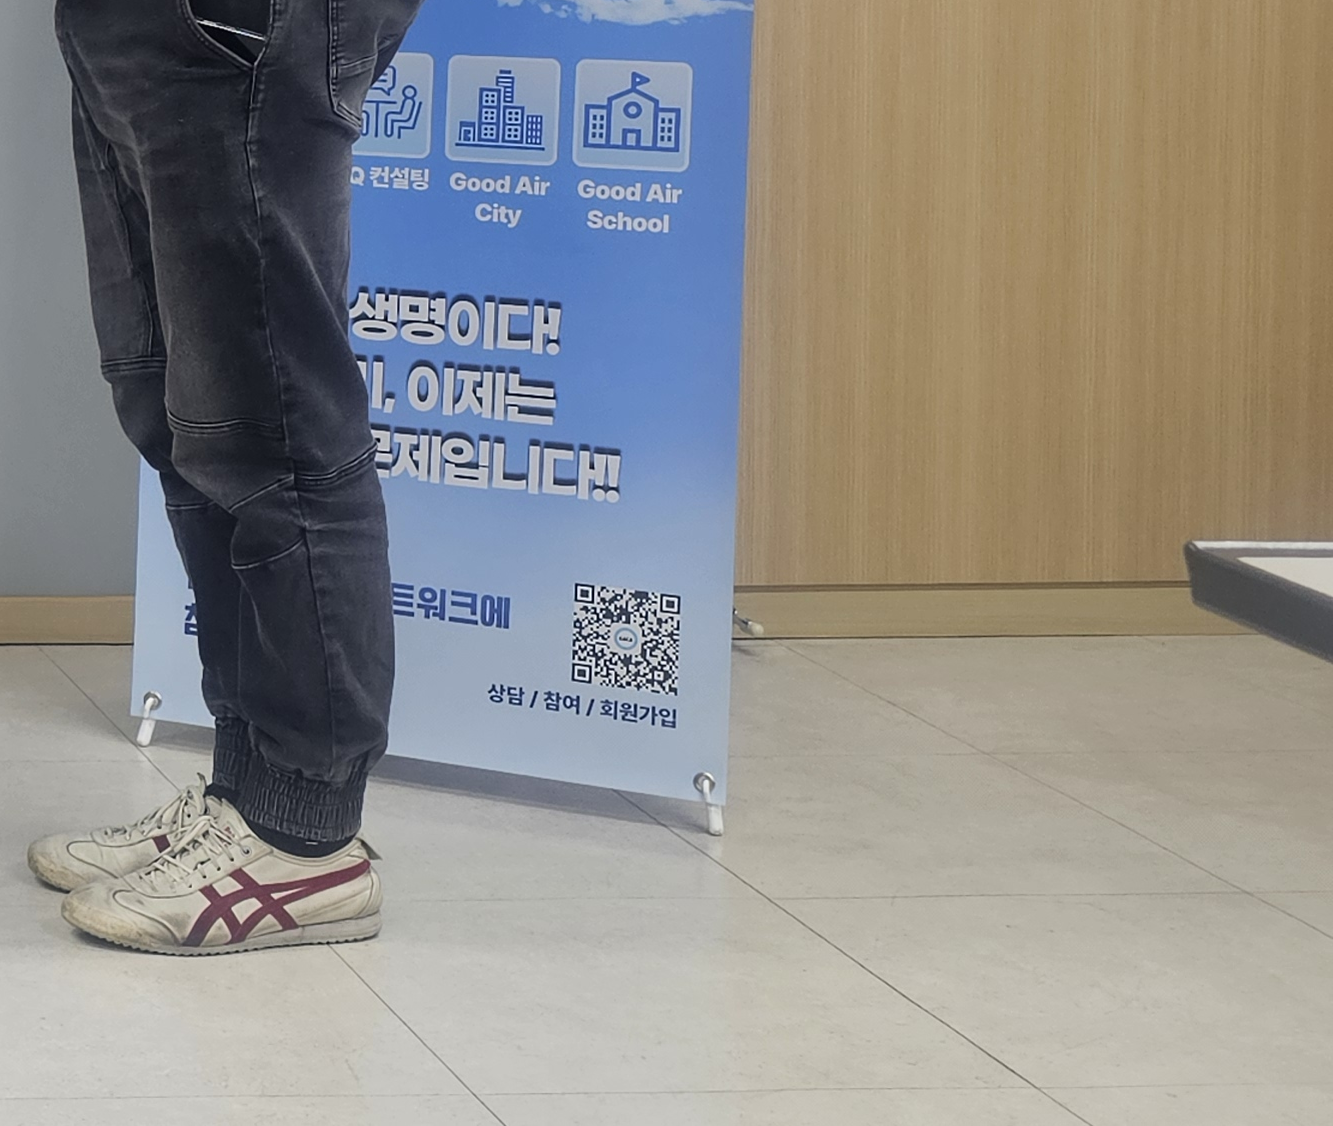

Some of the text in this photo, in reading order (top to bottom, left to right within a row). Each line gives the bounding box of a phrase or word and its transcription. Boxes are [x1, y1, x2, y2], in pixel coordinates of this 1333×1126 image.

[369, 165, 430, 191] 컨설팅
[449, 172, 551, 197] Good Air
[577, 179, 683, 204] Good Air
[474, 202, 523, 229] City
[586, 209, 670, 234] School
[349, 291, 562, 356] 생명이다!
[406, 365, 557, 426] 이제는
[487, 683, 526, 707] 상담
[543, 690, 582, 716] 참여
[599, 699, 678, 730] 회원가입
